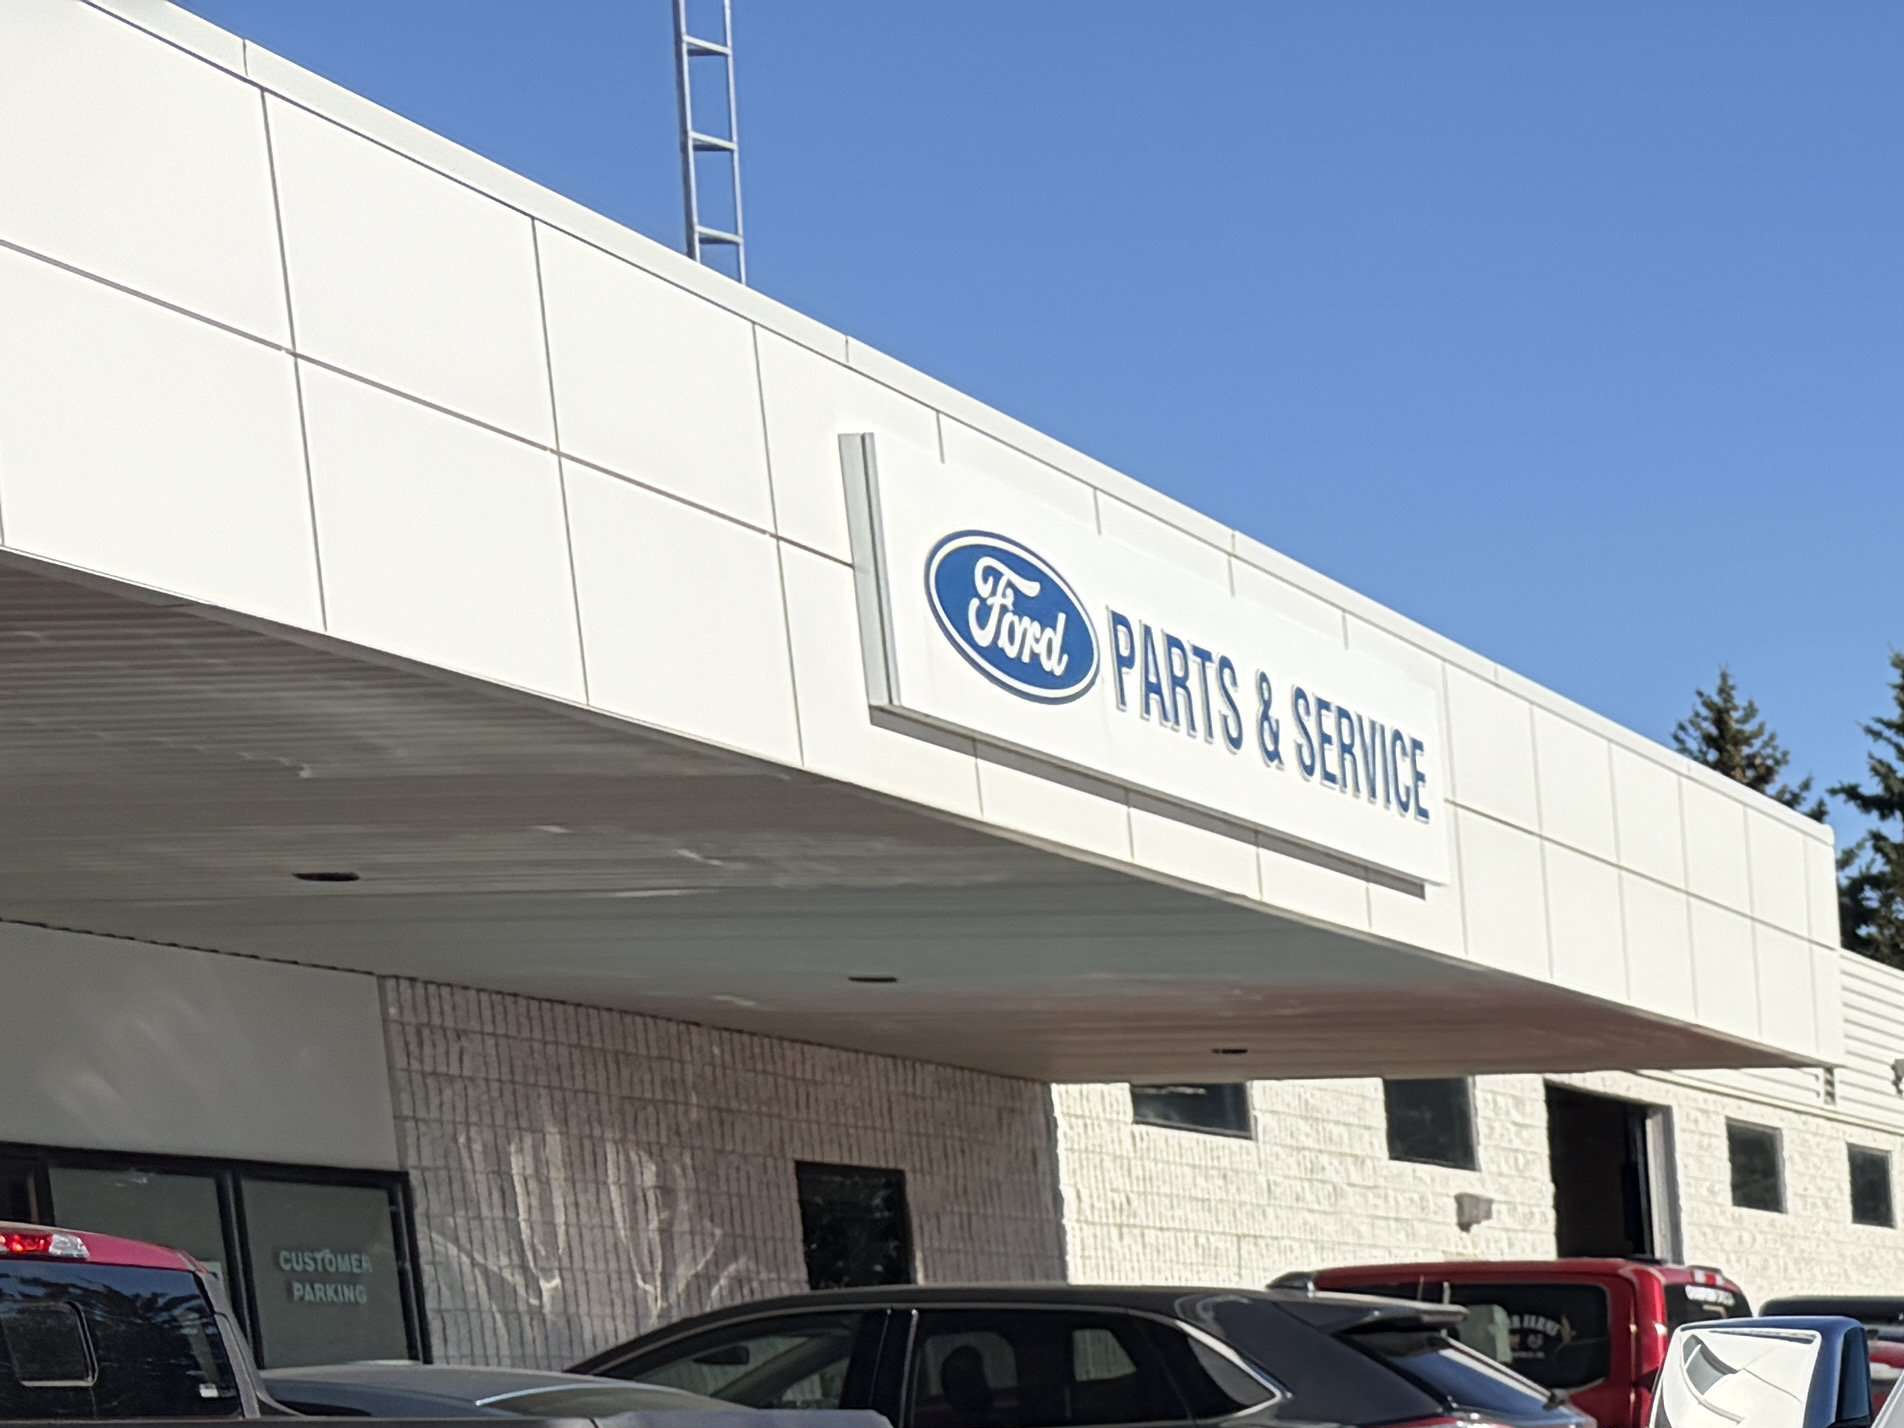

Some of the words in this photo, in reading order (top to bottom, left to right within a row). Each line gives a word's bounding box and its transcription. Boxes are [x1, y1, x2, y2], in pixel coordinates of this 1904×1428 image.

[968, 556, 1070, 677] Ford
[1107, 606, 1243, 754] PARTS
[1256, 670, 1284, 768] &
[1291, 684, 1430, 823] SERVICE
[279, 1248, 372, 1273] CUSTOMER
[292, 1281, 368, 1305] PARKING
